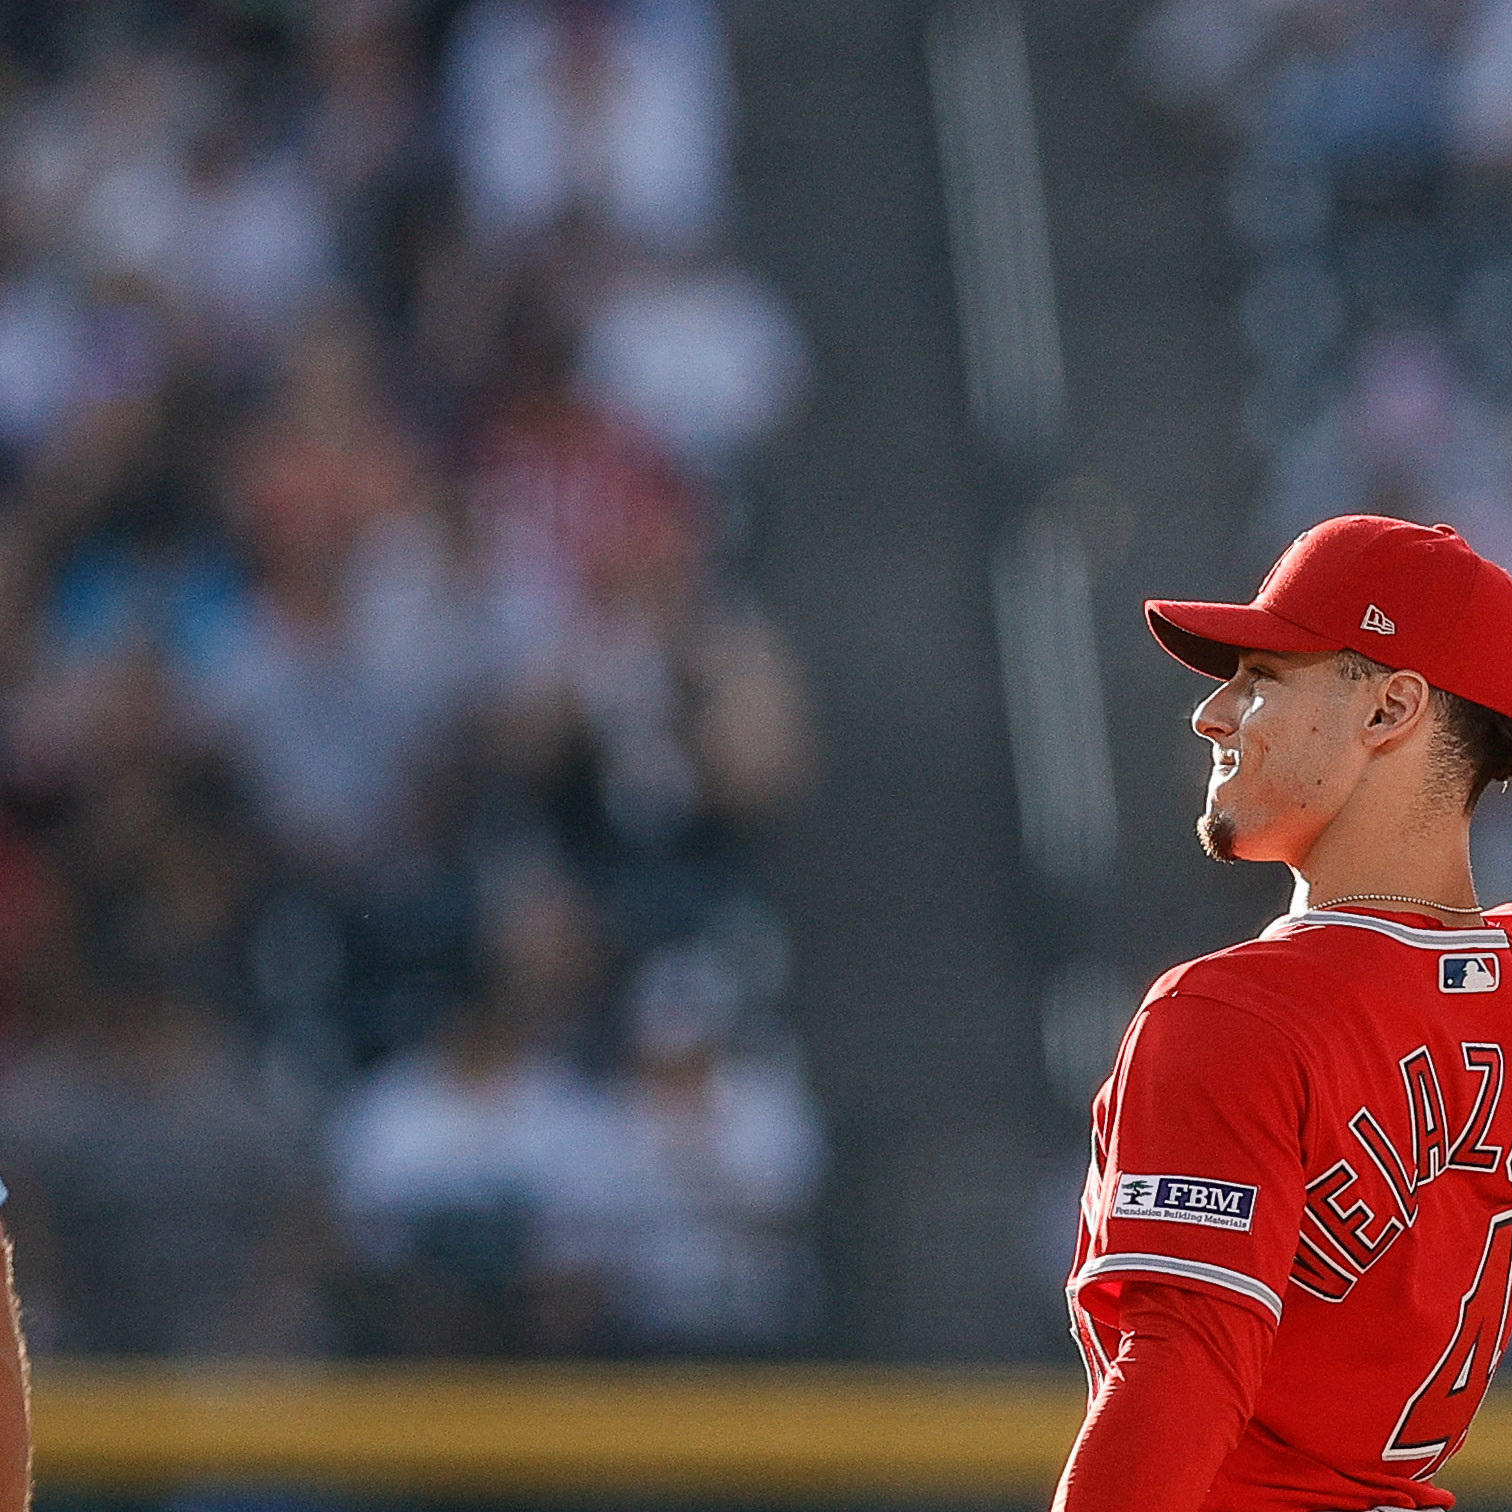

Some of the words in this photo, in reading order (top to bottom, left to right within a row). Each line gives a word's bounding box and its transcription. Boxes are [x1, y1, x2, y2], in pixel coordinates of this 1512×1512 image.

[1164, 1182, 1244, 1214] FBM
[1114, 1206, 1162, 1217] Foundation
[1163, 1209, 1203, 1222] Building
[1203, 1214, 1248, 1229] Materials
